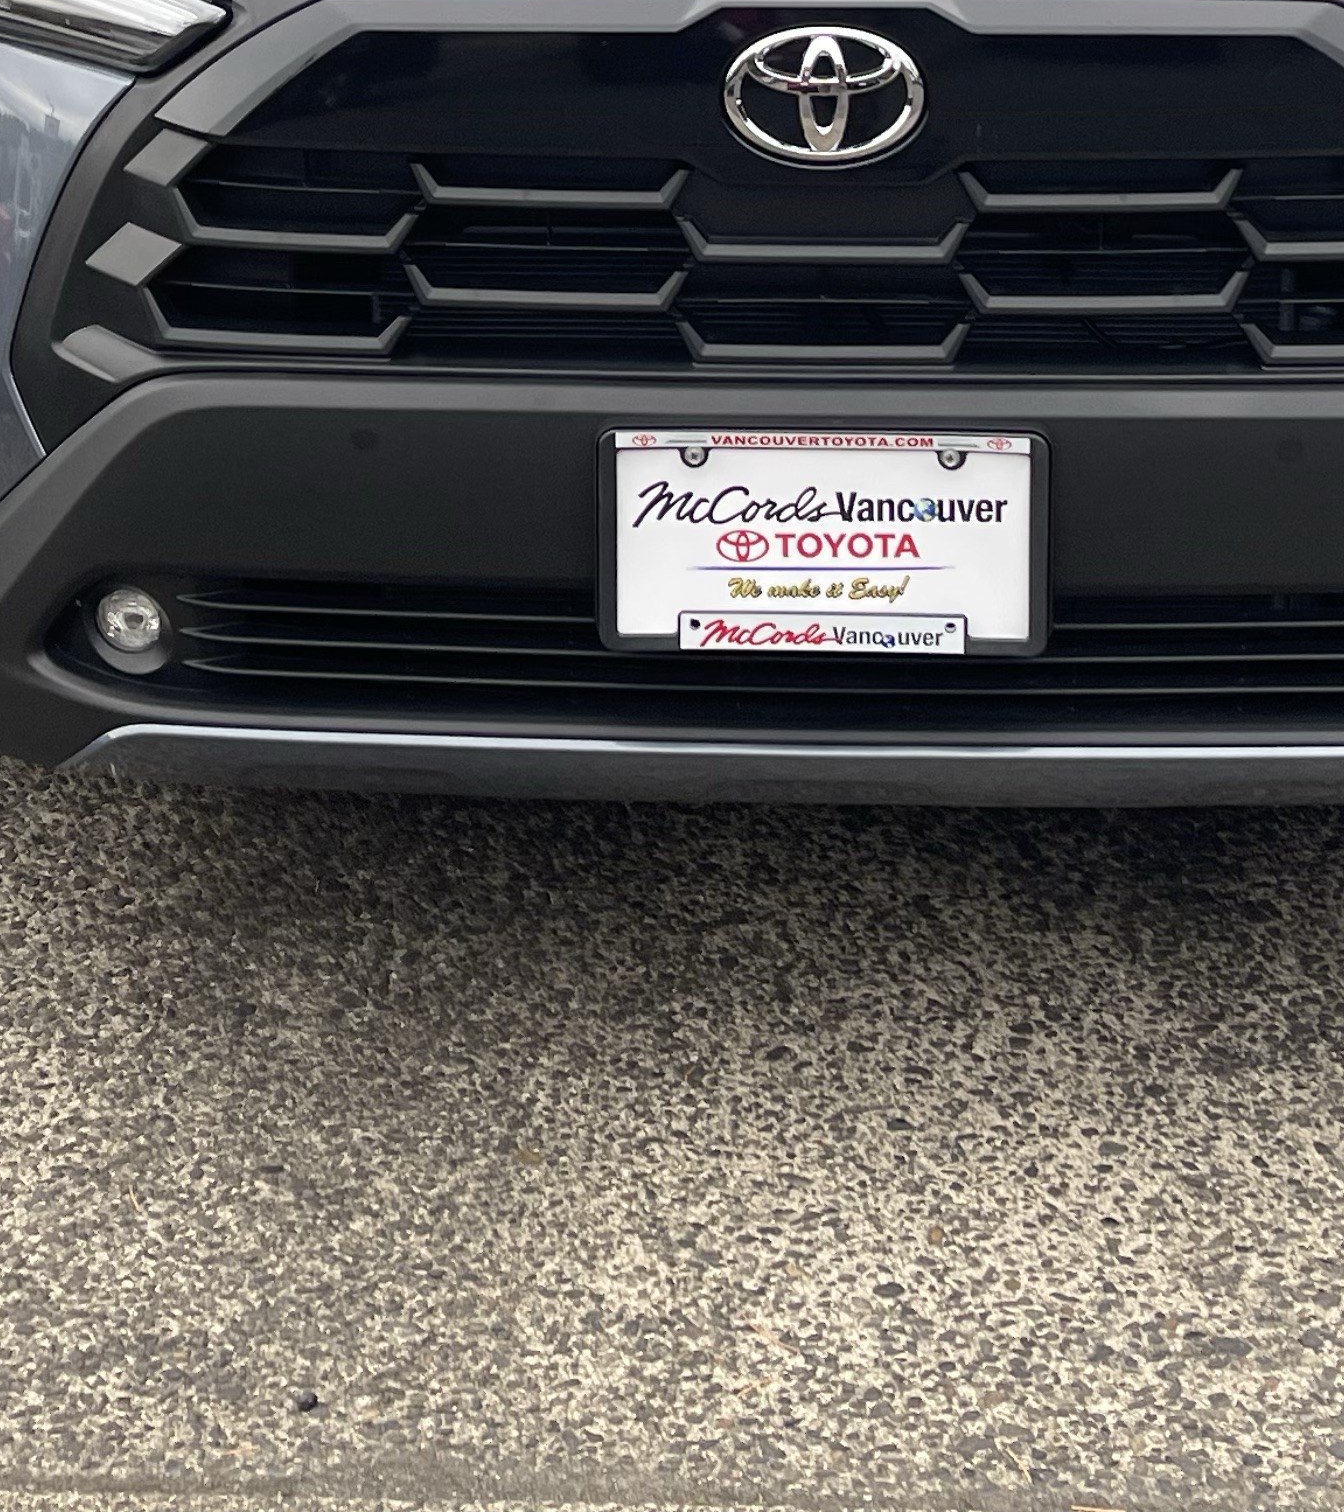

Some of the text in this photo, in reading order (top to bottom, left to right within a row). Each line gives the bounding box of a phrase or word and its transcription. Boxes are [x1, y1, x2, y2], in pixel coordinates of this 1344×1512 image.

[710, 434, 934, 447] VANCOUVERTOYOTA.COM
[632, 480, 1008, 528] McCords Vancouver
[774, 532, 921, 559] TOYOTA
[727, 575, 911, 604] We make it Easy!
[699, 619, 944, 648] McCords Vancouver
